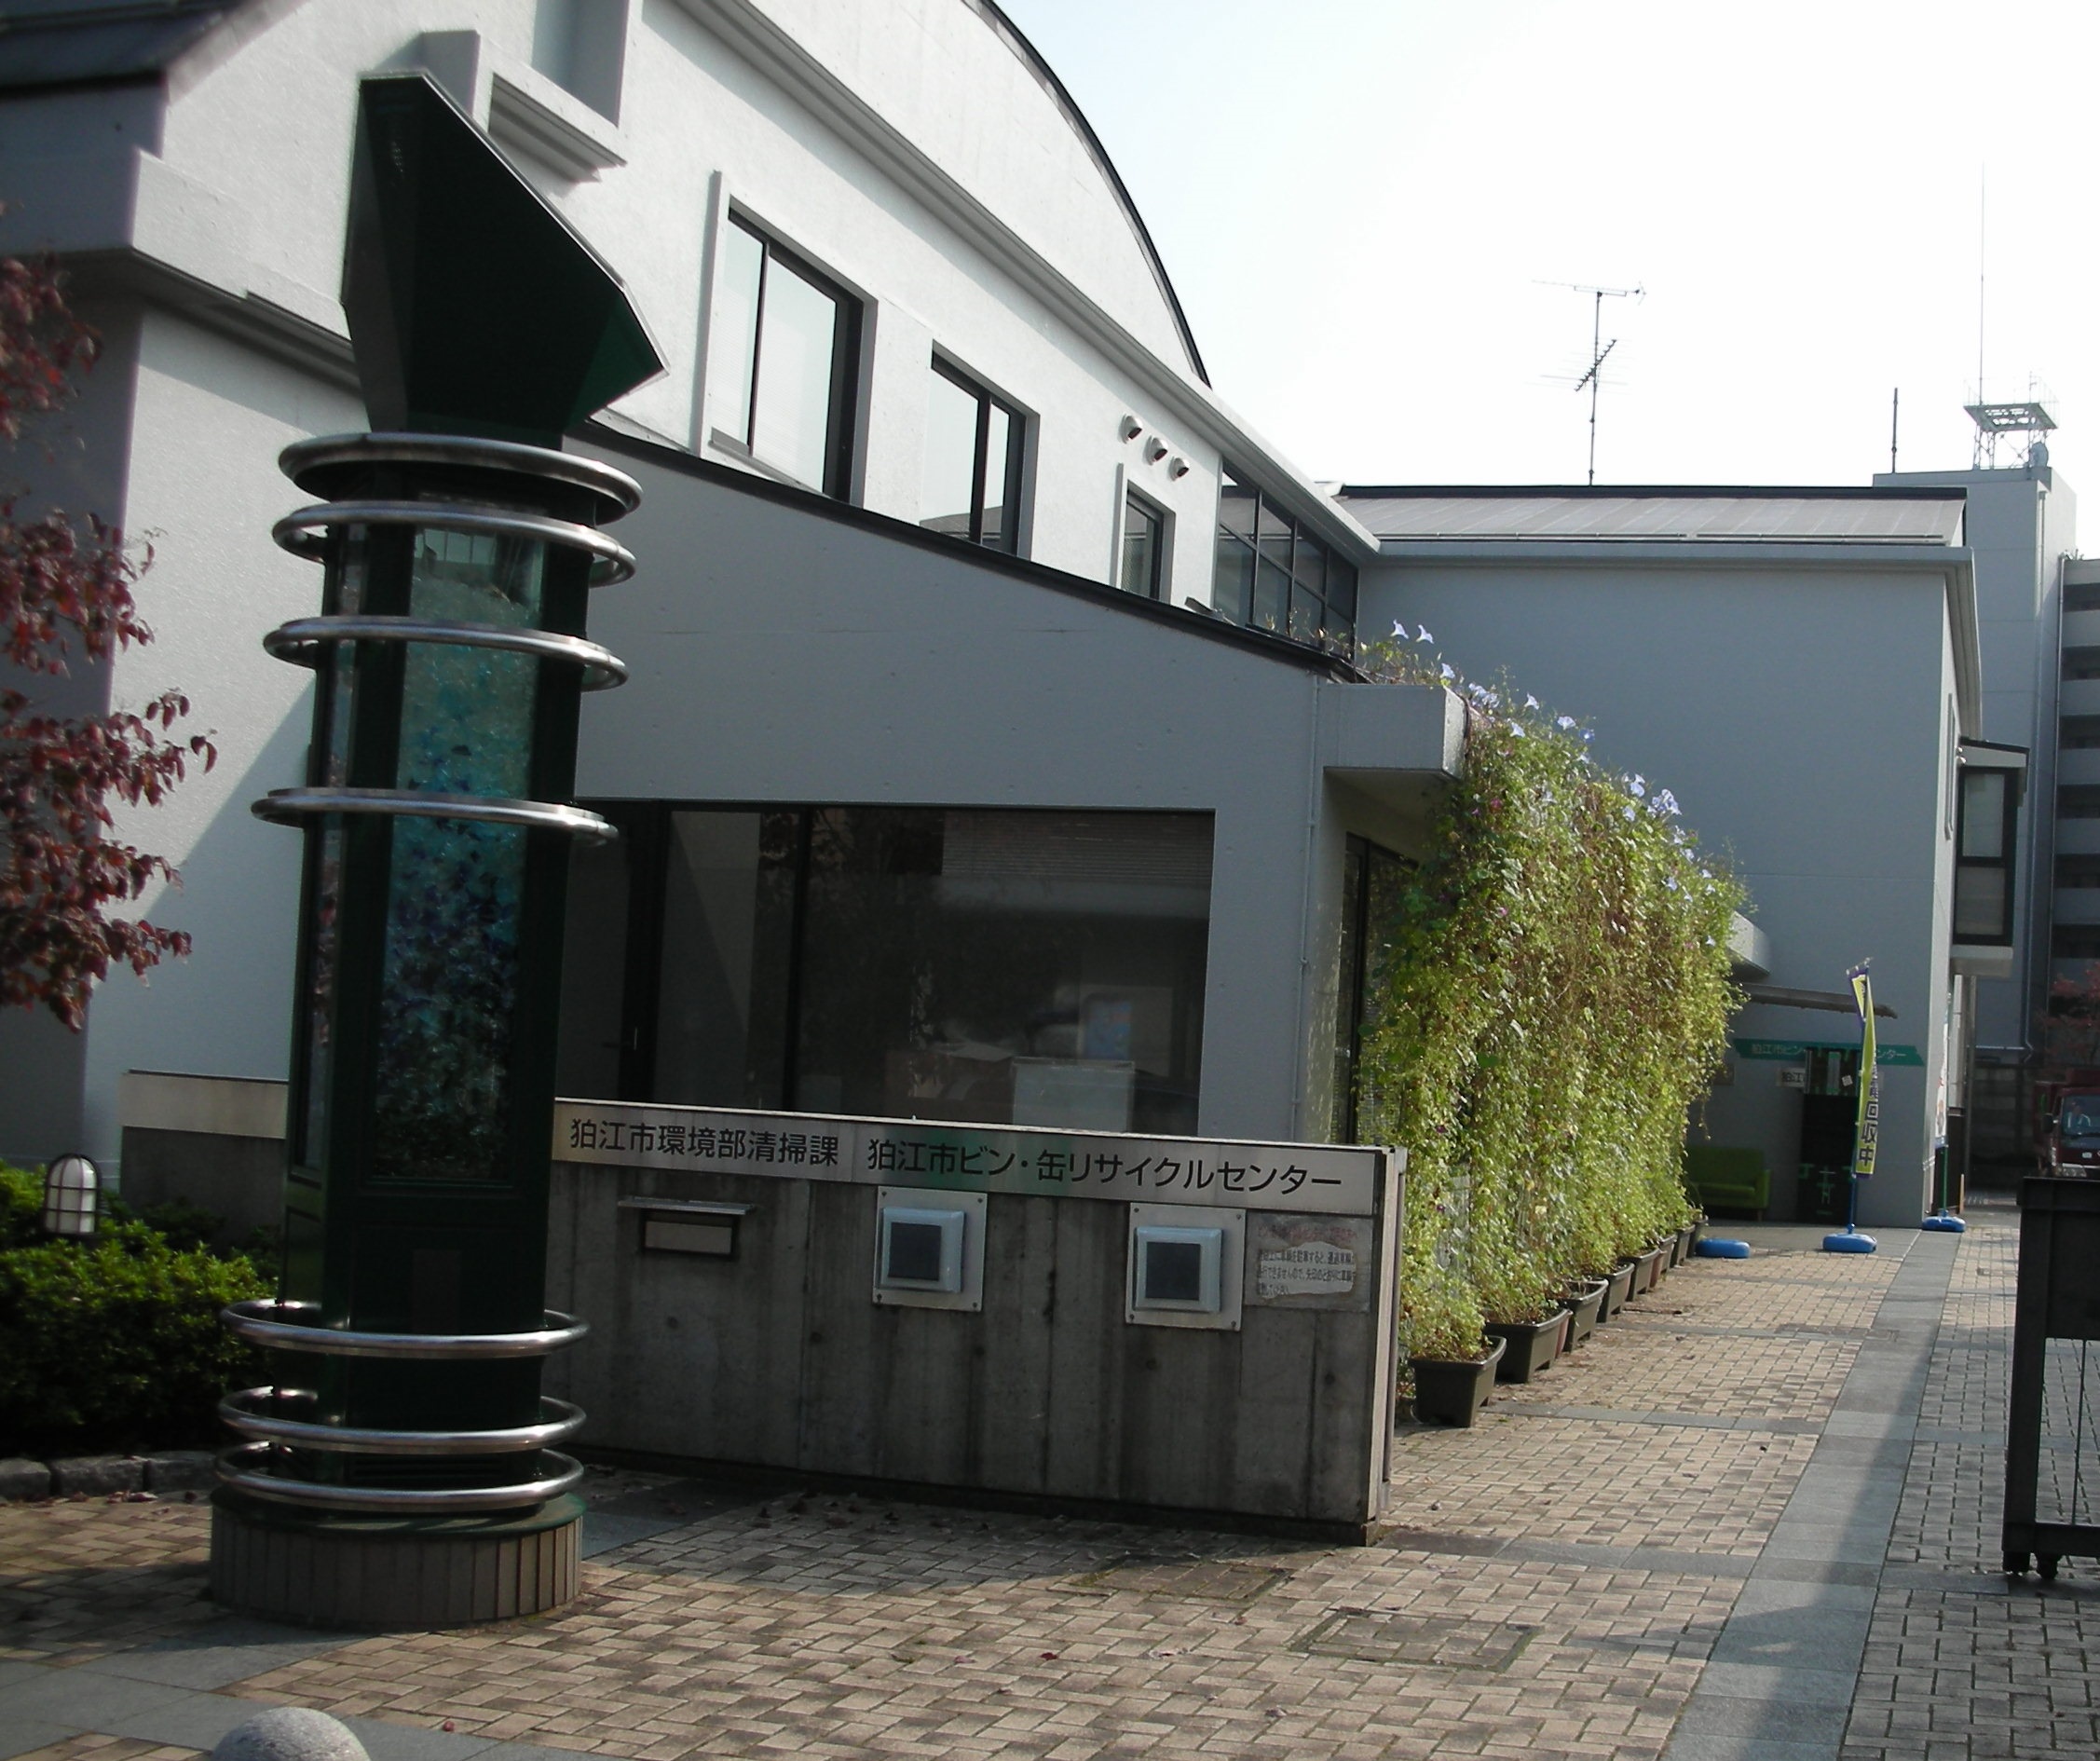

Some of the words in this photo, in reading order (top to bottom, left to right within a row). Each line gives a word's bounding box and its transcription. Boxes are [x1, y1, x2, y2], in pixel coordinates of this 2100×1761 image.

[570, 1118, 839, 1167] 狛江市環境部清掃課
[867, 1139, 1342, 1194] 狛江市ビン・缶リサイクルセンター
